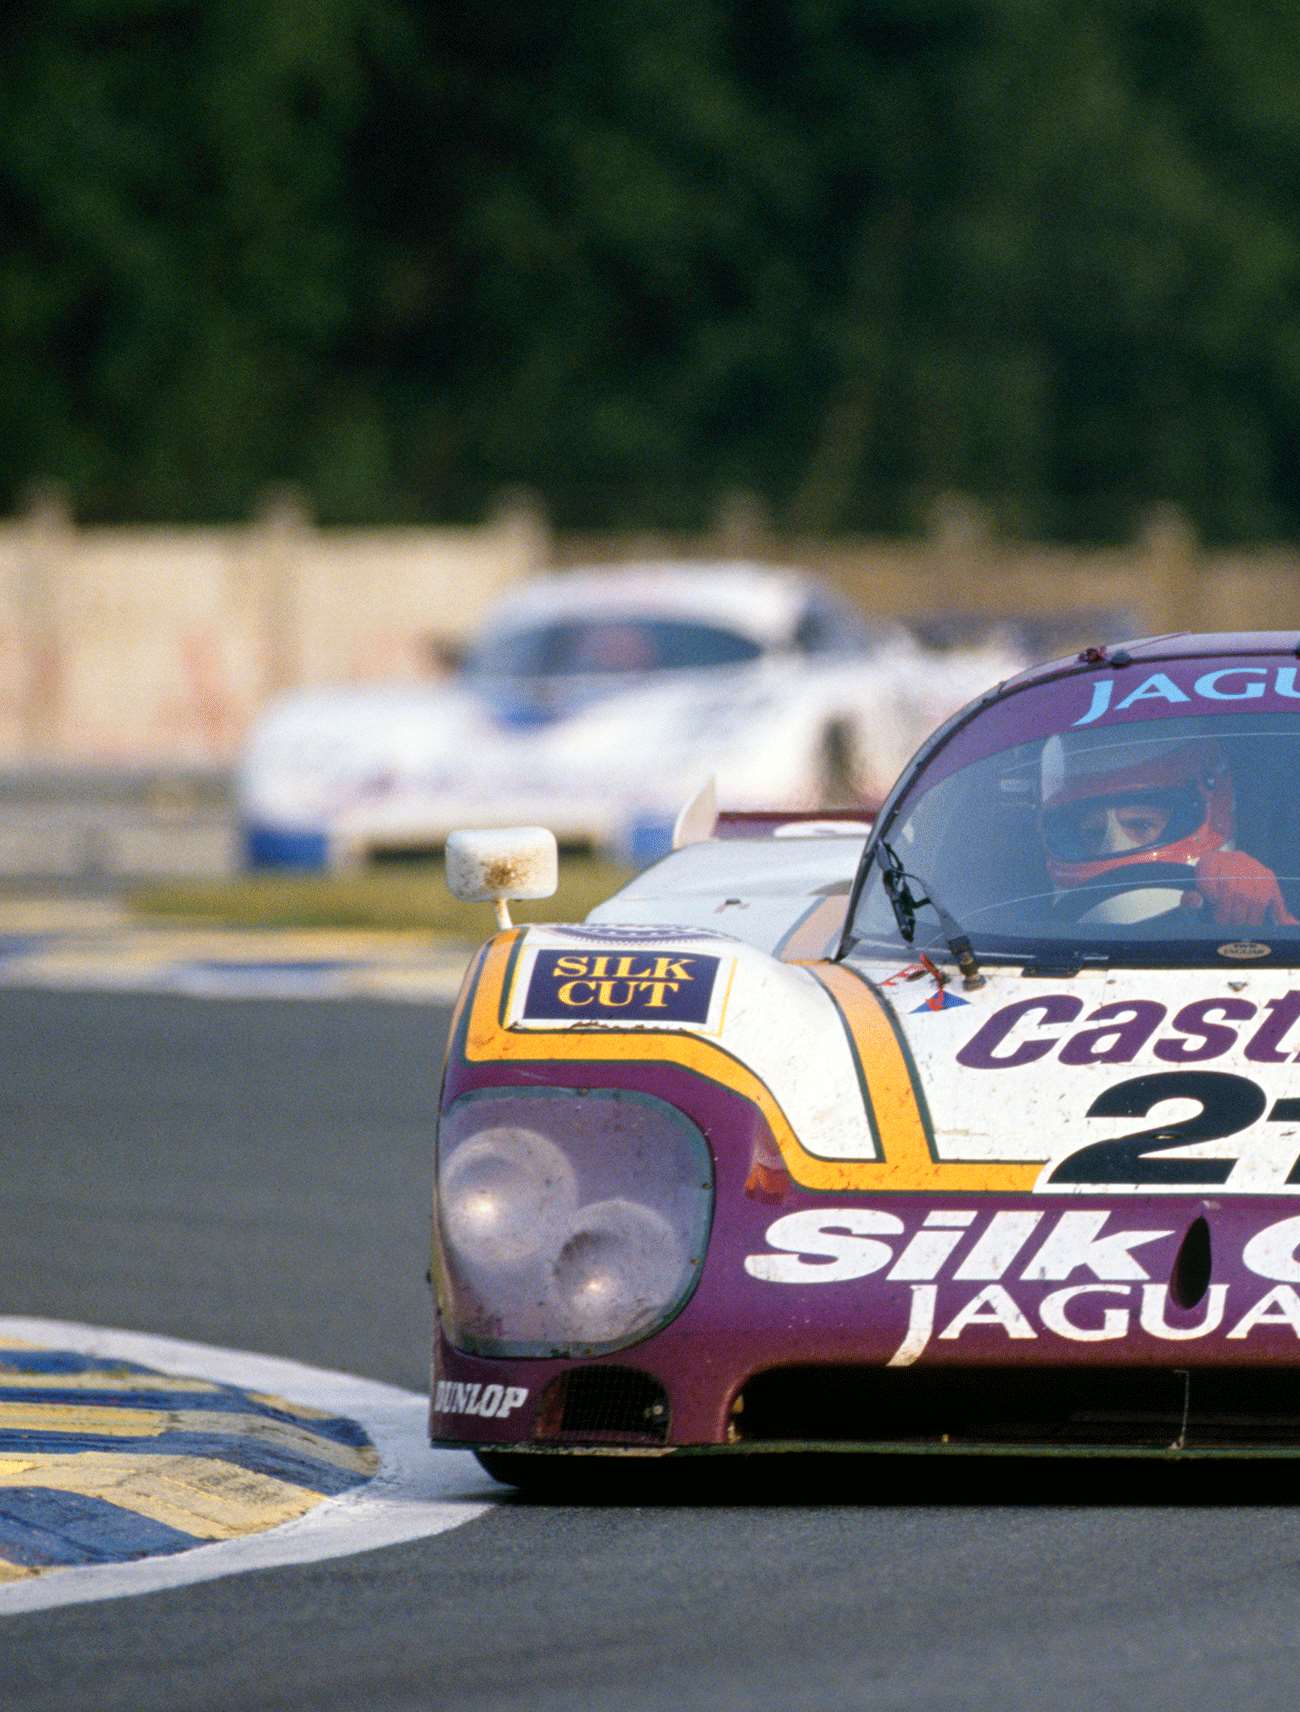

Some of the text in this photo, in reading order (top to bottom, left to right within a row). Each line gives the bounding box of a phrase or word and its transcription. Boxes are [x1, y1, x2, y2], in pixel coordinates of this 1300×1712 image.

[553, 955, 697, 980] SILK
[557, 980, 680, 1008] CUT
[743, 1208, 1178, 1284] Silk
[433, 1379, 529, 1419] DUNLOP
